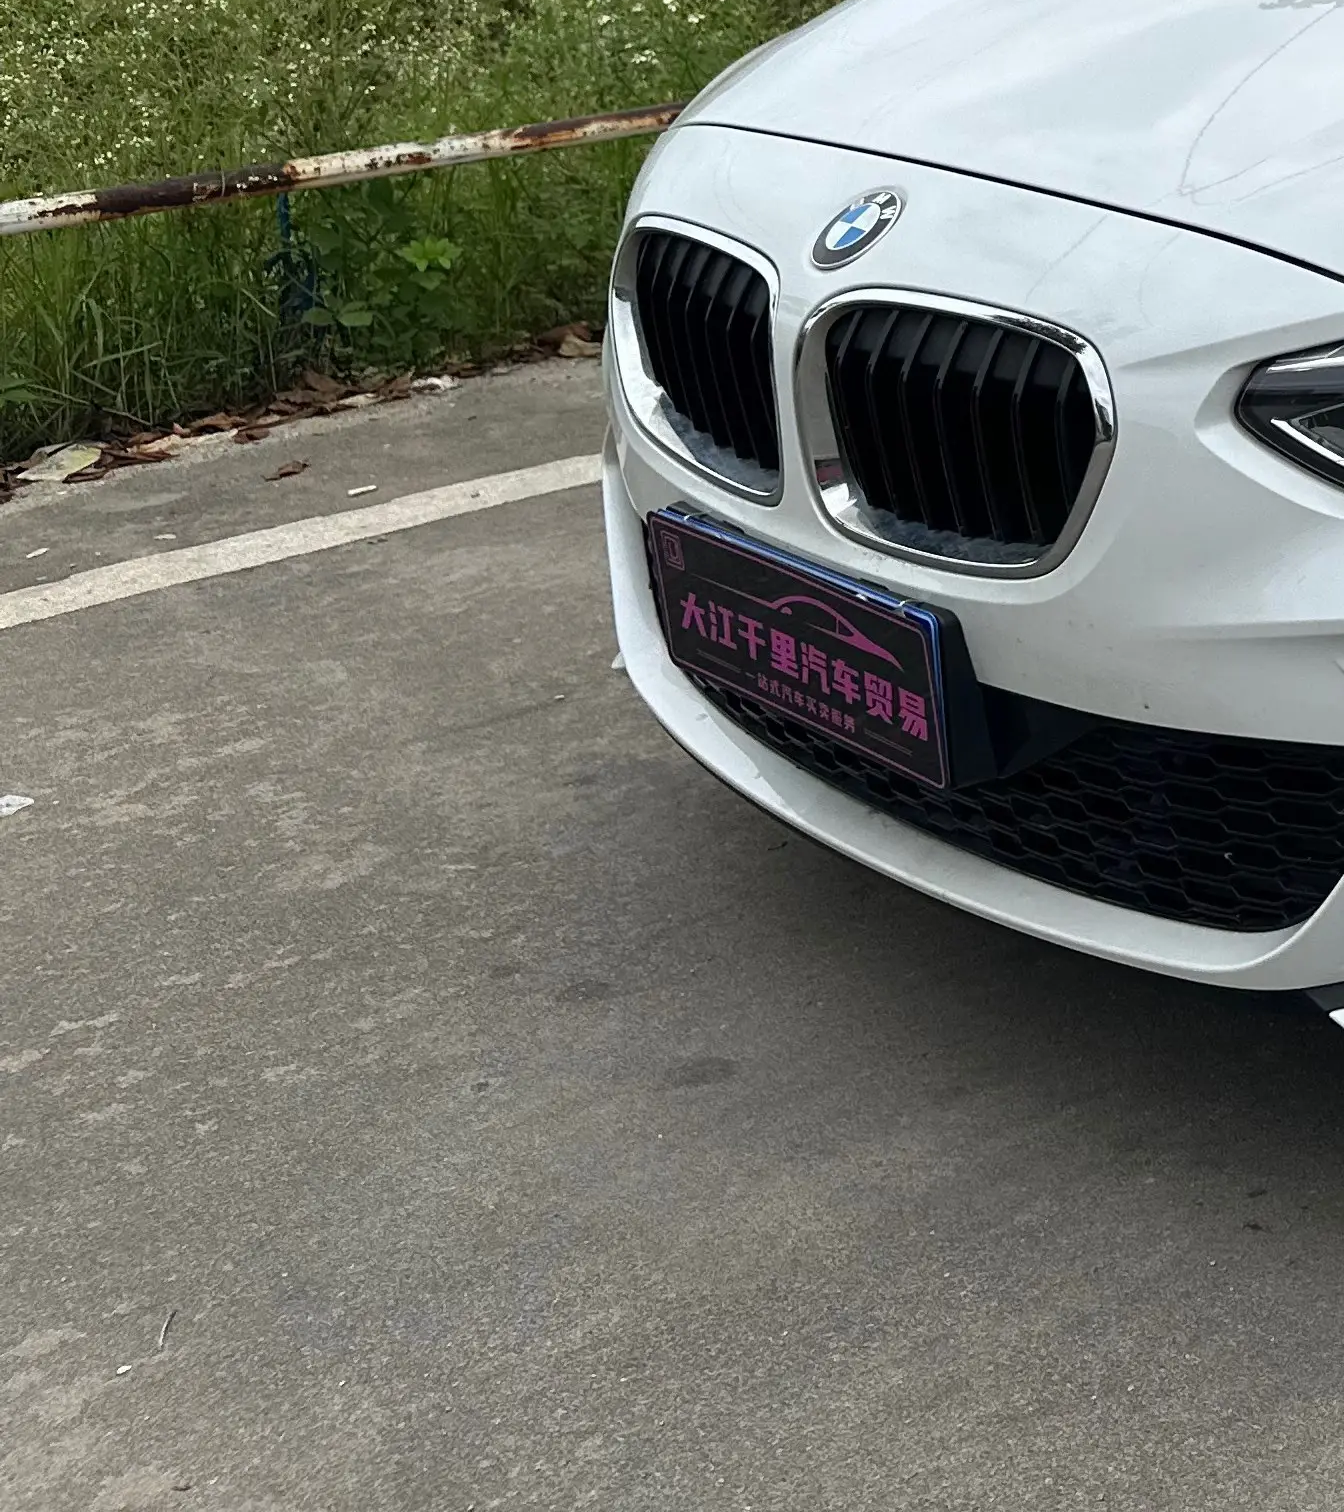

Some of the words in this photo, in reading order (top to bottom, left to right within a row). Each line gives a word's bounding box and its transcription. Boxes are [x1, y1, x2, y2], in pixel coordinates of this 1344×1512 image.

[680, 592, 929, 741] 大江千里汽车贸易
[745, 671, 856, 734] 一站式汽车买卖服务
